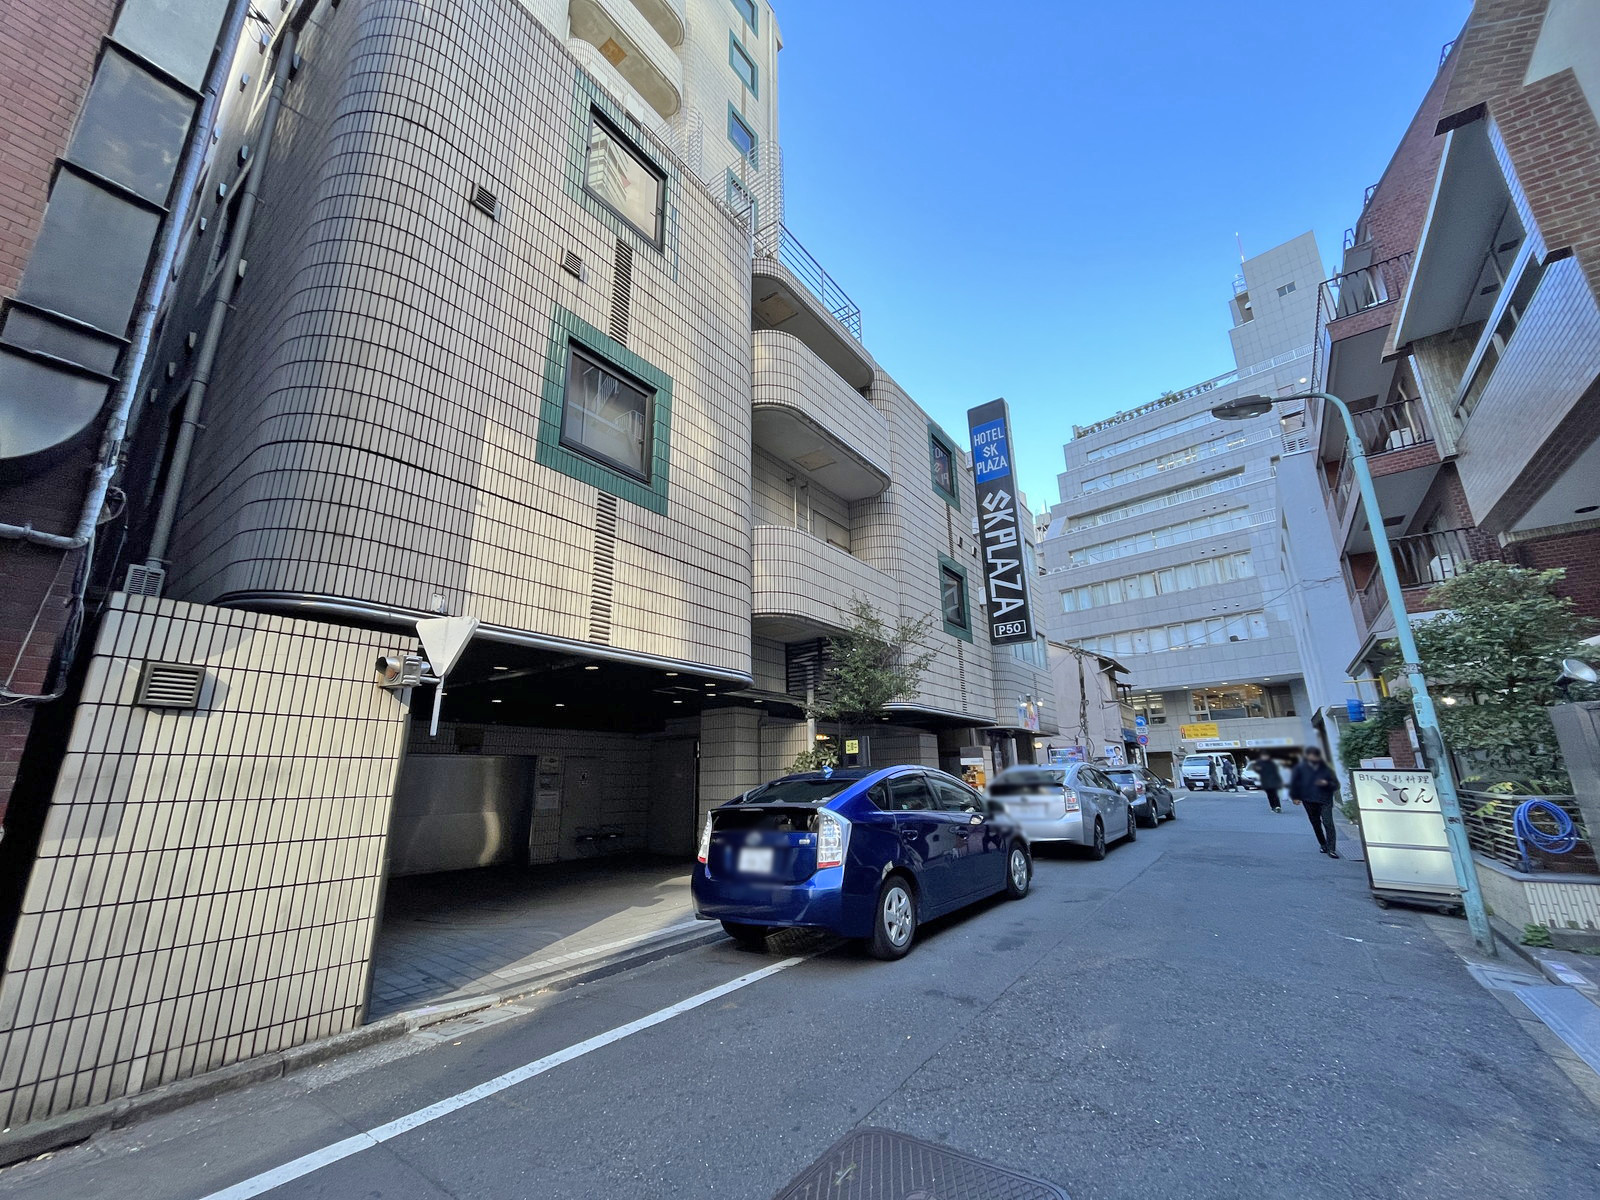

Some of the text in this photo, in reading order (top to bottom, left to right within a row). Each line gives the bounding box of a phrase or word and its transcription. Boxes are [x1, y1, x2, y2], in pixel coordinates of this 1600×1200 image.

[973, 426, 1005, 447] HOTEL
[982, 442, 999, 458] SK
[976, 455, 1008, 476] PLAZA
[998, 622, 1022, 635] P50
[1392, 787, 1434, 804] てん
